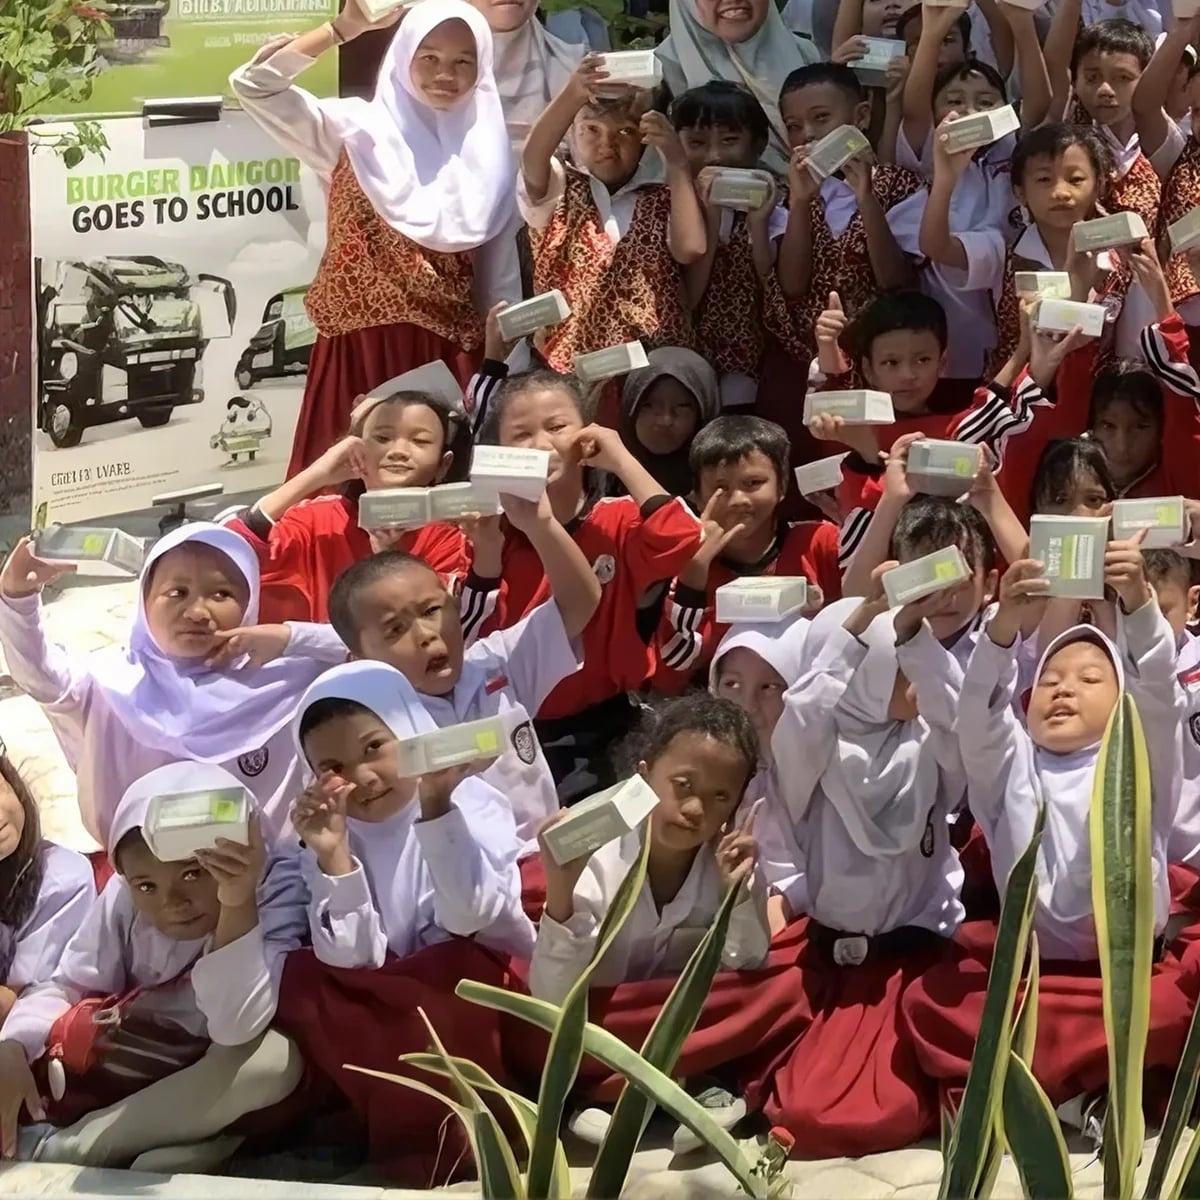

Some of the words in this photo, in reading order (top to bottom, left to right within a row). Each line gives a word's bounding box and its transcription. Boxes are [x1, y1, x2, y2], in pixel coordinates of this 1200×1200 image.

[66, 169, 180, 204] BURGER
[72, 200, 145, 233] GOES
[153, 197, 188, 225] TO
[196, 186, 299, 220] SCHOOL
